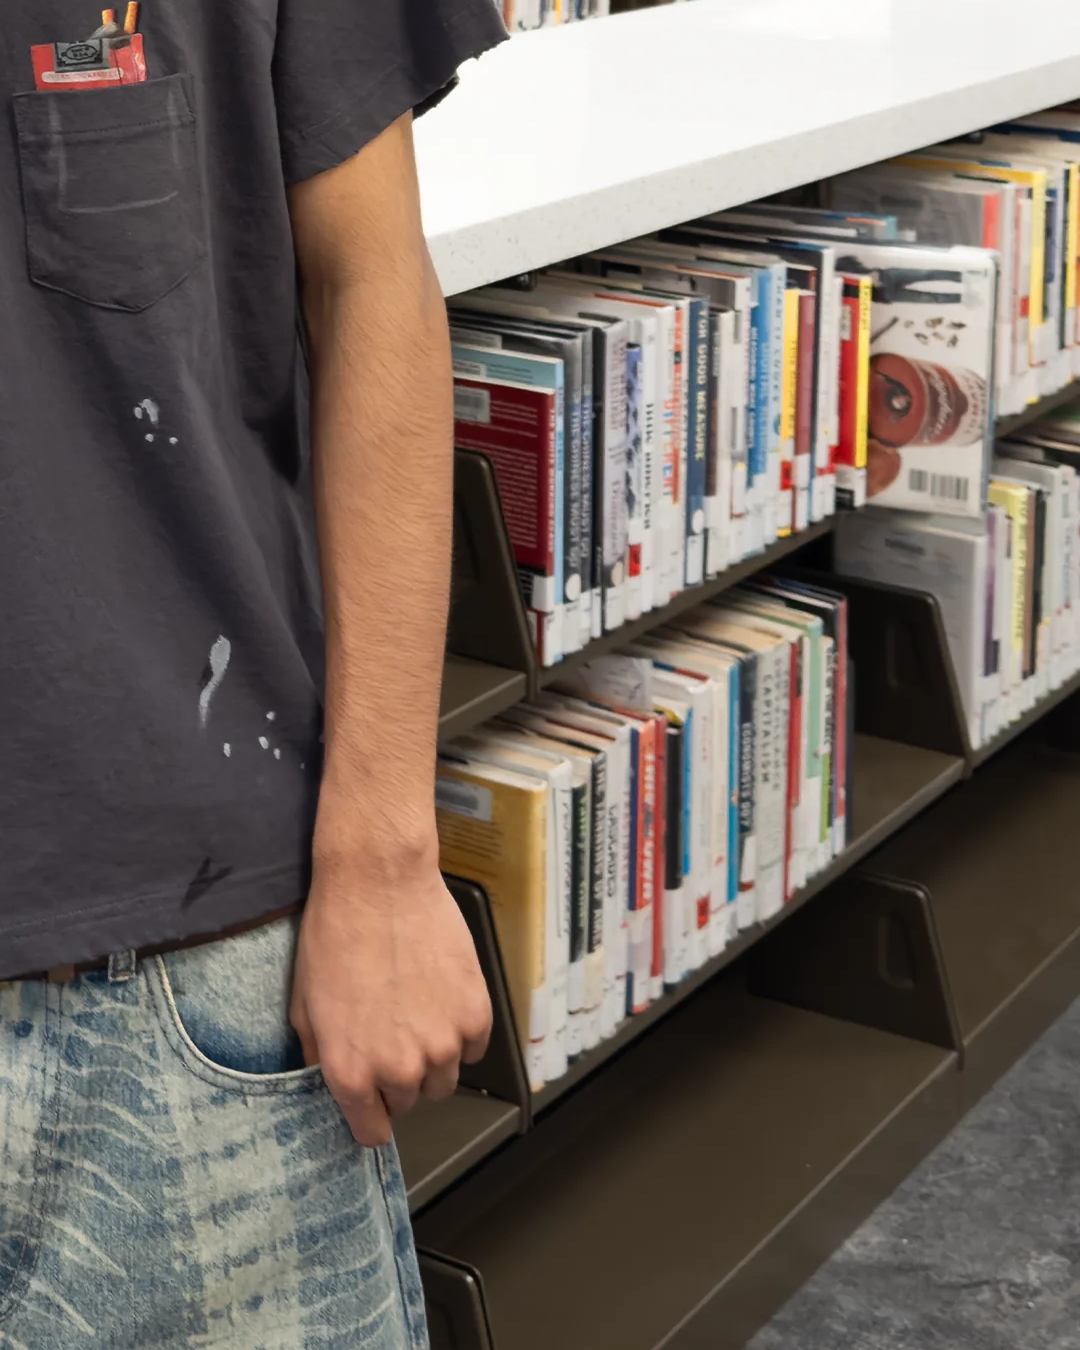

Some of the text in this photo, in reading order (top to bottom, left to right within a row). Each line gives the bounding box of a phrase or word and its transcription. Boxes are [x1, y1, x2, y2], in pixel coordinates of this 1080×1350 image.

[695, 309, 707, 461] FOR GOOD MEASURE
[571, 411, 581, 434] THE
[582, 402, 592, 429] THE
[571, 439, 580, 499] CHINESE
[582, 431, 591, 489] CHINESE
[570, 502, 580, 542] MUST
[582, 493, 590, 532] MUST
[761, 673, 772, 783] CAPITALISM
[740, 722, 753, 797] ECONOMISTS
[608, 804, 618, 897] CASCADES
